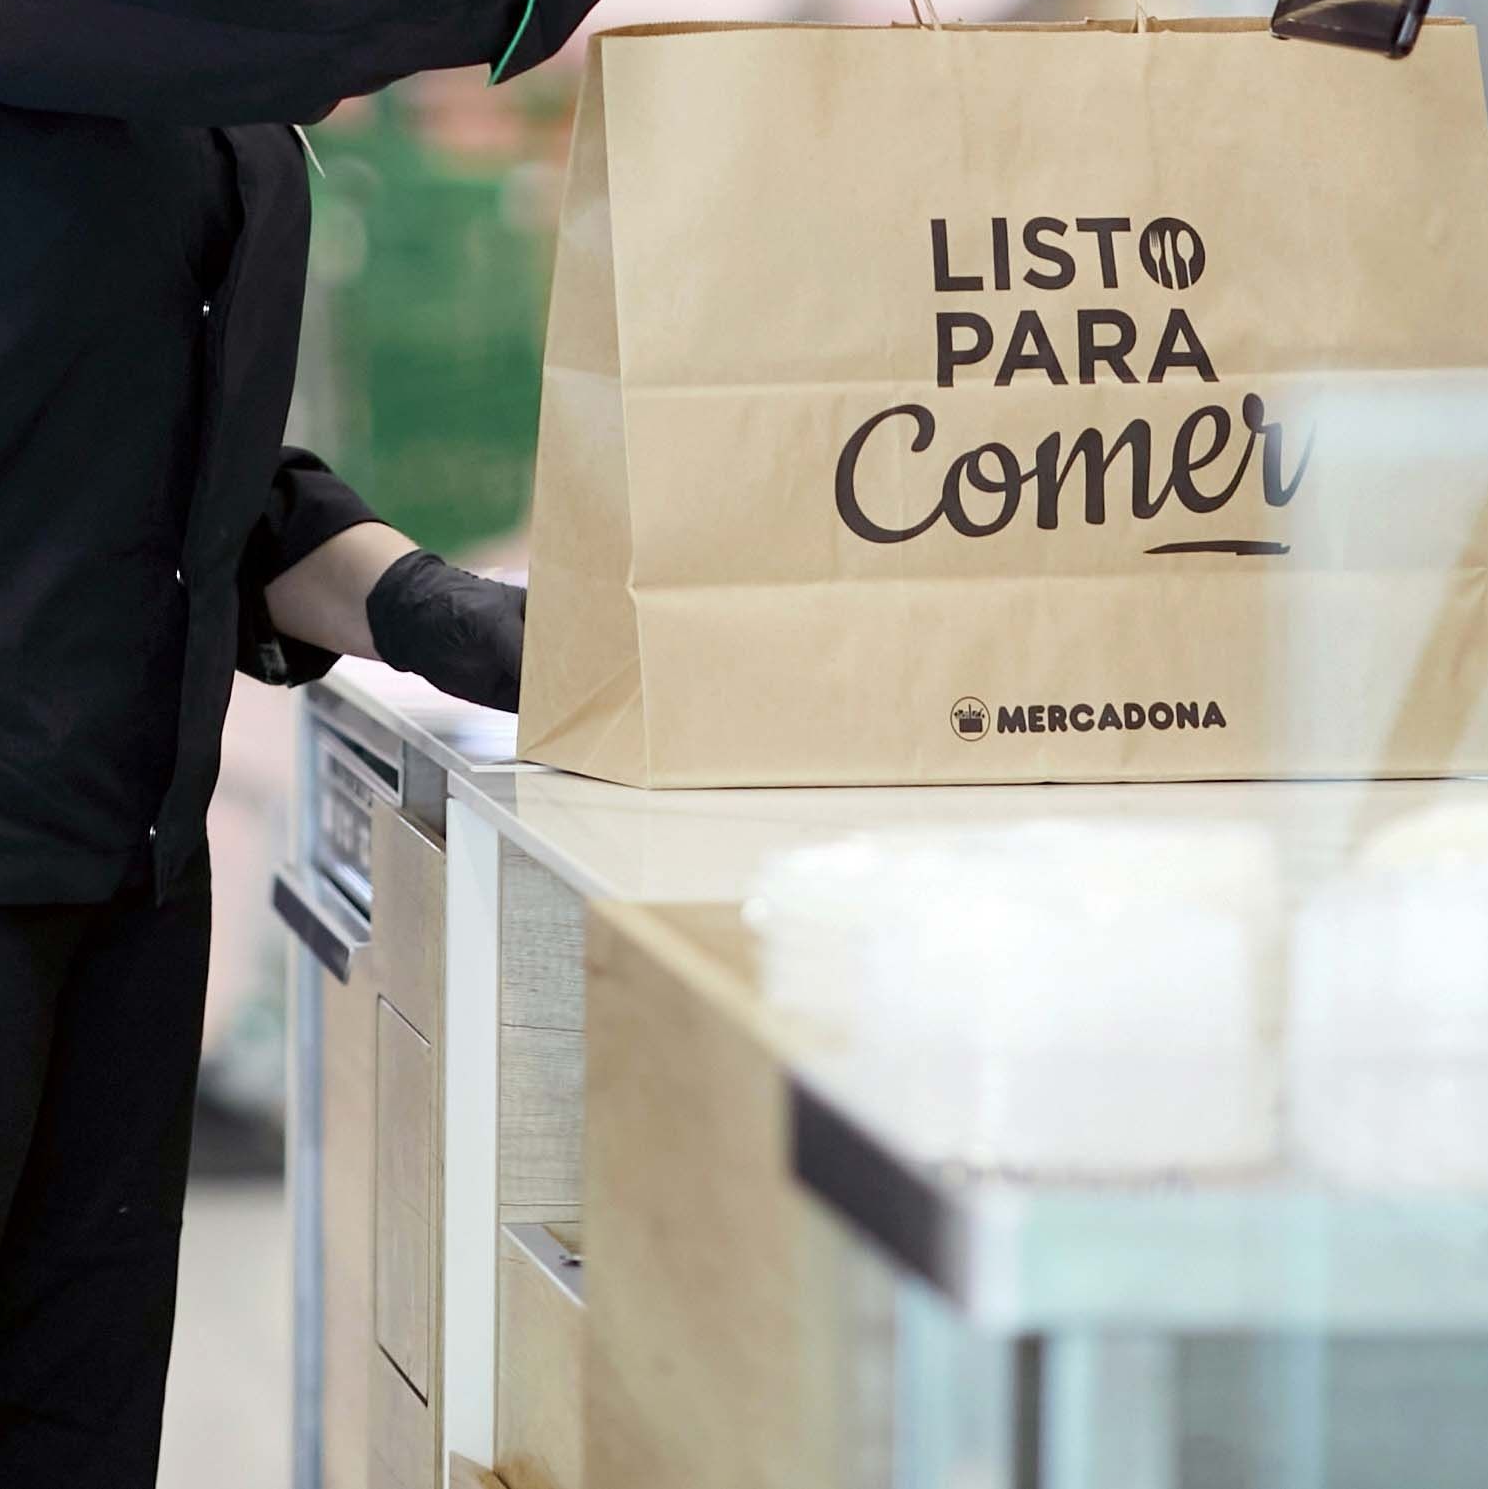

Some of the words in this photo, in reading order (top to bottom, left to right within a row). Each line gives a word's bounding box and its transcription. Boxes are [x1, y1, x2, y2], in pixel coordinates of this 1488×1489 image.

[935, 308, 1220, 387] PARA
[834, 392, 1317, 544] Comer
[997, 701, 1227, 734] MERCADONA
